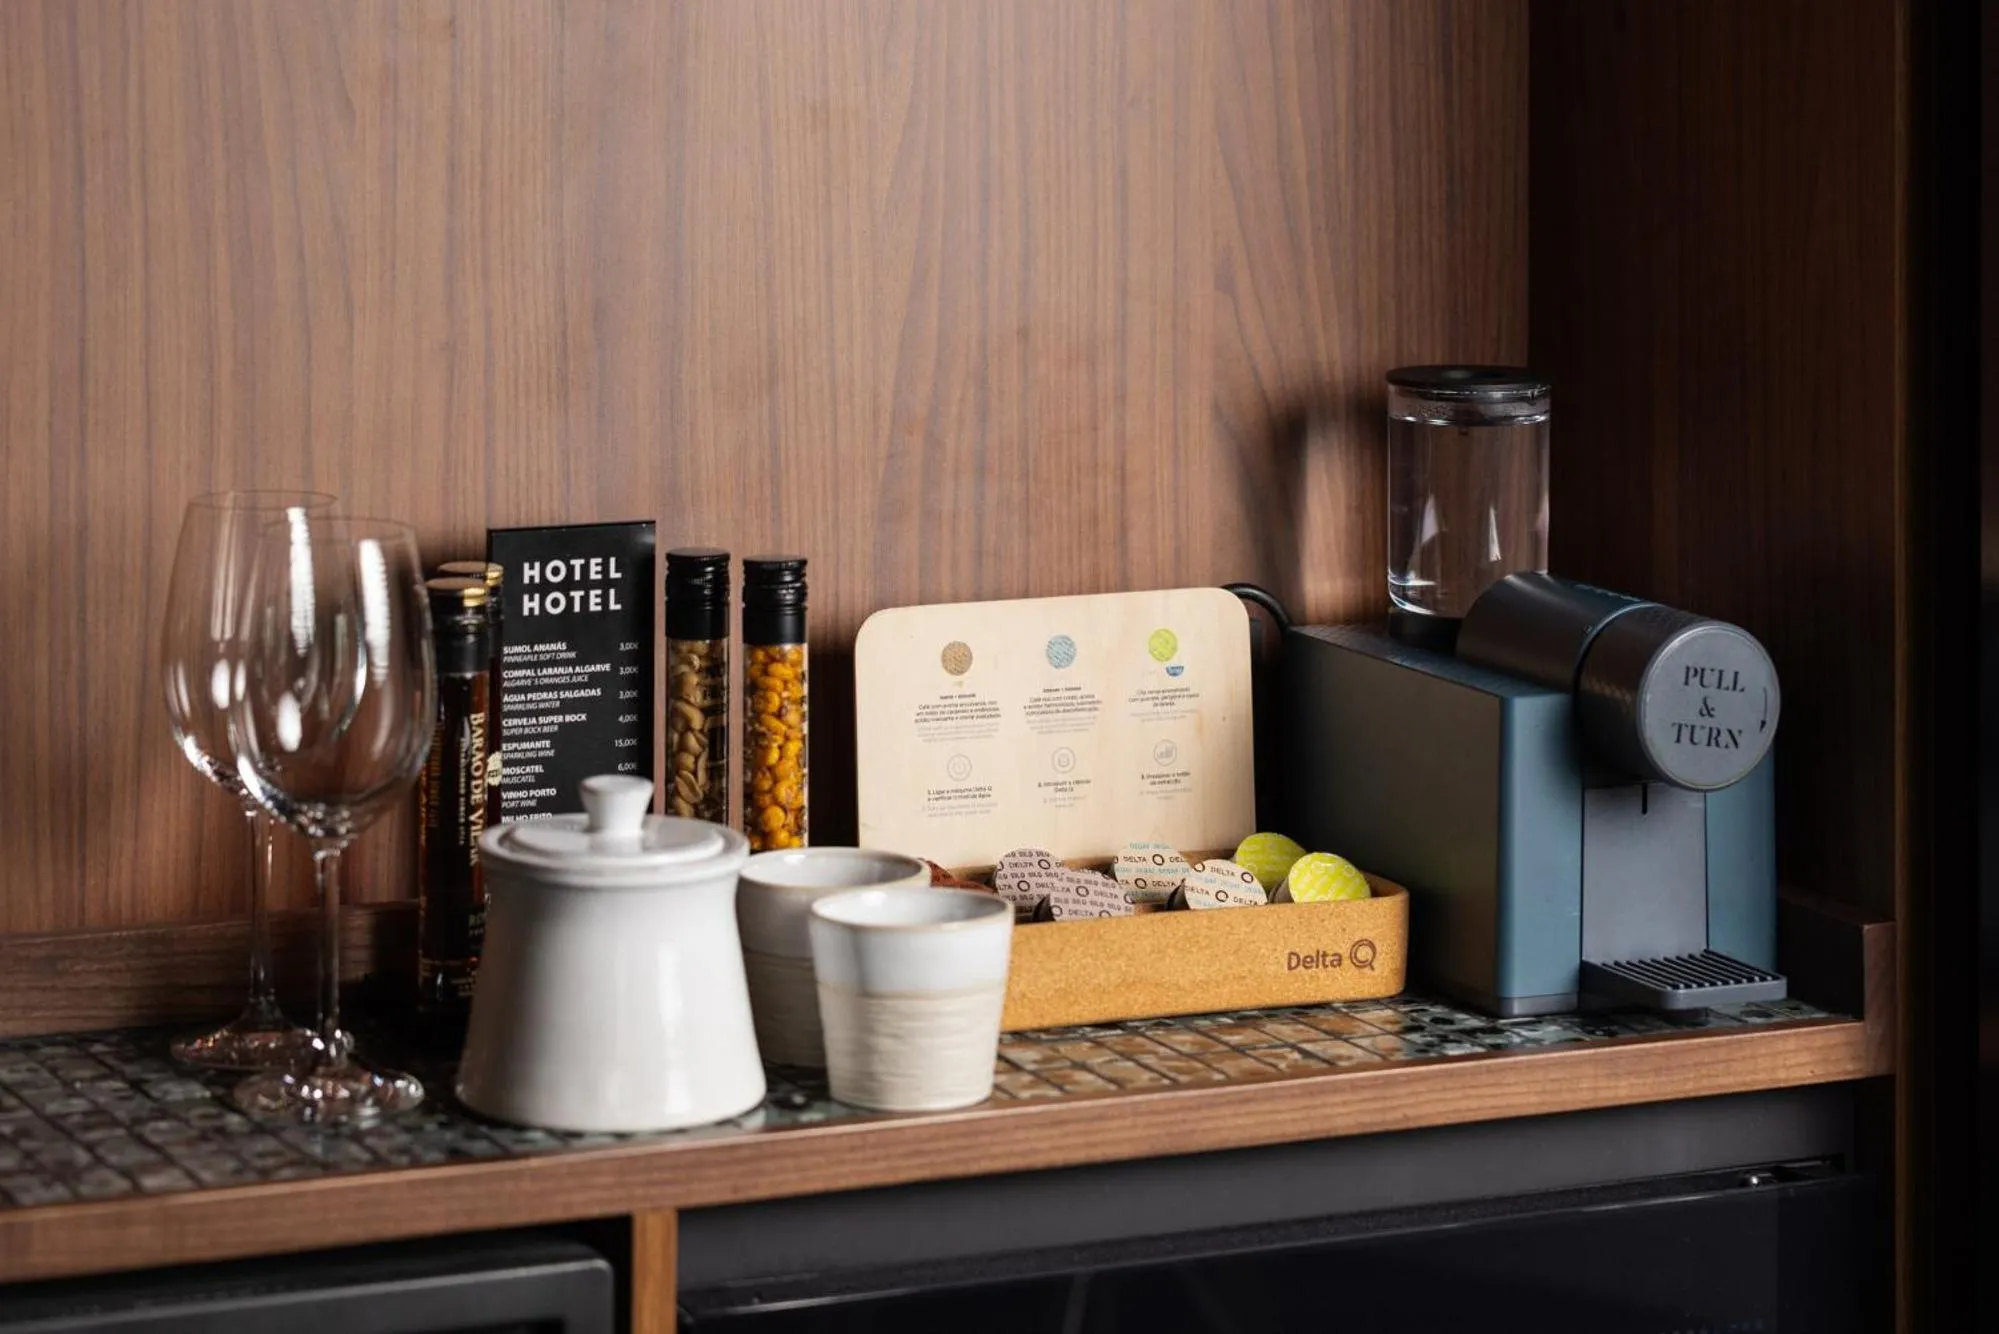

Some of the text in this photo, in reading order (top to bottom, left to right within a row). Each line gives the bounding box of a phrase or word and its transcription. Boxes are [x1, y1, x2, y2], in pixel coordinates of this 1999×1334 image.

[523, 556, 623, 584] HOTEL
[522, 588, 623, 616] HOTEL
[503, 644, 532, 654] SUMOL
[533, 641, 567, 652] ANANÁS
[539, 652, 556, 661] SOFT
[556, 651, 577, 659] DRINK
[503, 668, 536, 678] COMPAL
[537, 666, 573, 676] LARANJA
[574, 663, 611, 673] ALGARVE
[1683, 665, 1746, 693] PULL
[503, 693, 526, 702] ÁGUA
[527, 691, 558, 701] PEDRAS
[559, 688, 602, 699] SALGADAS
[503, 700, 560, 711] SPARKLING WATER
[1698, 695, 1716, 718] &
[503, 716, 537, 726] CERVEJA
[538, 714, 563, 724] SUPER
[565, 713, 587, 722] BOCK
[523, 725, 541, 734] BOCK
[1671, 722, 1743, 750] TURN
[502, 740, 551, 751] ESPUMANTE
[502, 765, 544, 775] MOSCATEL
[470, 780, 484, 806] DE
[501, 788, 557, 800] VINHO PORTO
[520, 798, 537, 807] WINE
[1008, 861, 1034, 869] DELTA
[1210, 866, 1236, 877] DELTA
[1152, 880, 1176, 888] DELTA
[1093, 890, 1119, 899] DELTA
[1233, 896, 1259, 906] DELTA
[1068, 908, 1094, 917] DELTA
[1287, 939, 1377, 972] Delta Q
